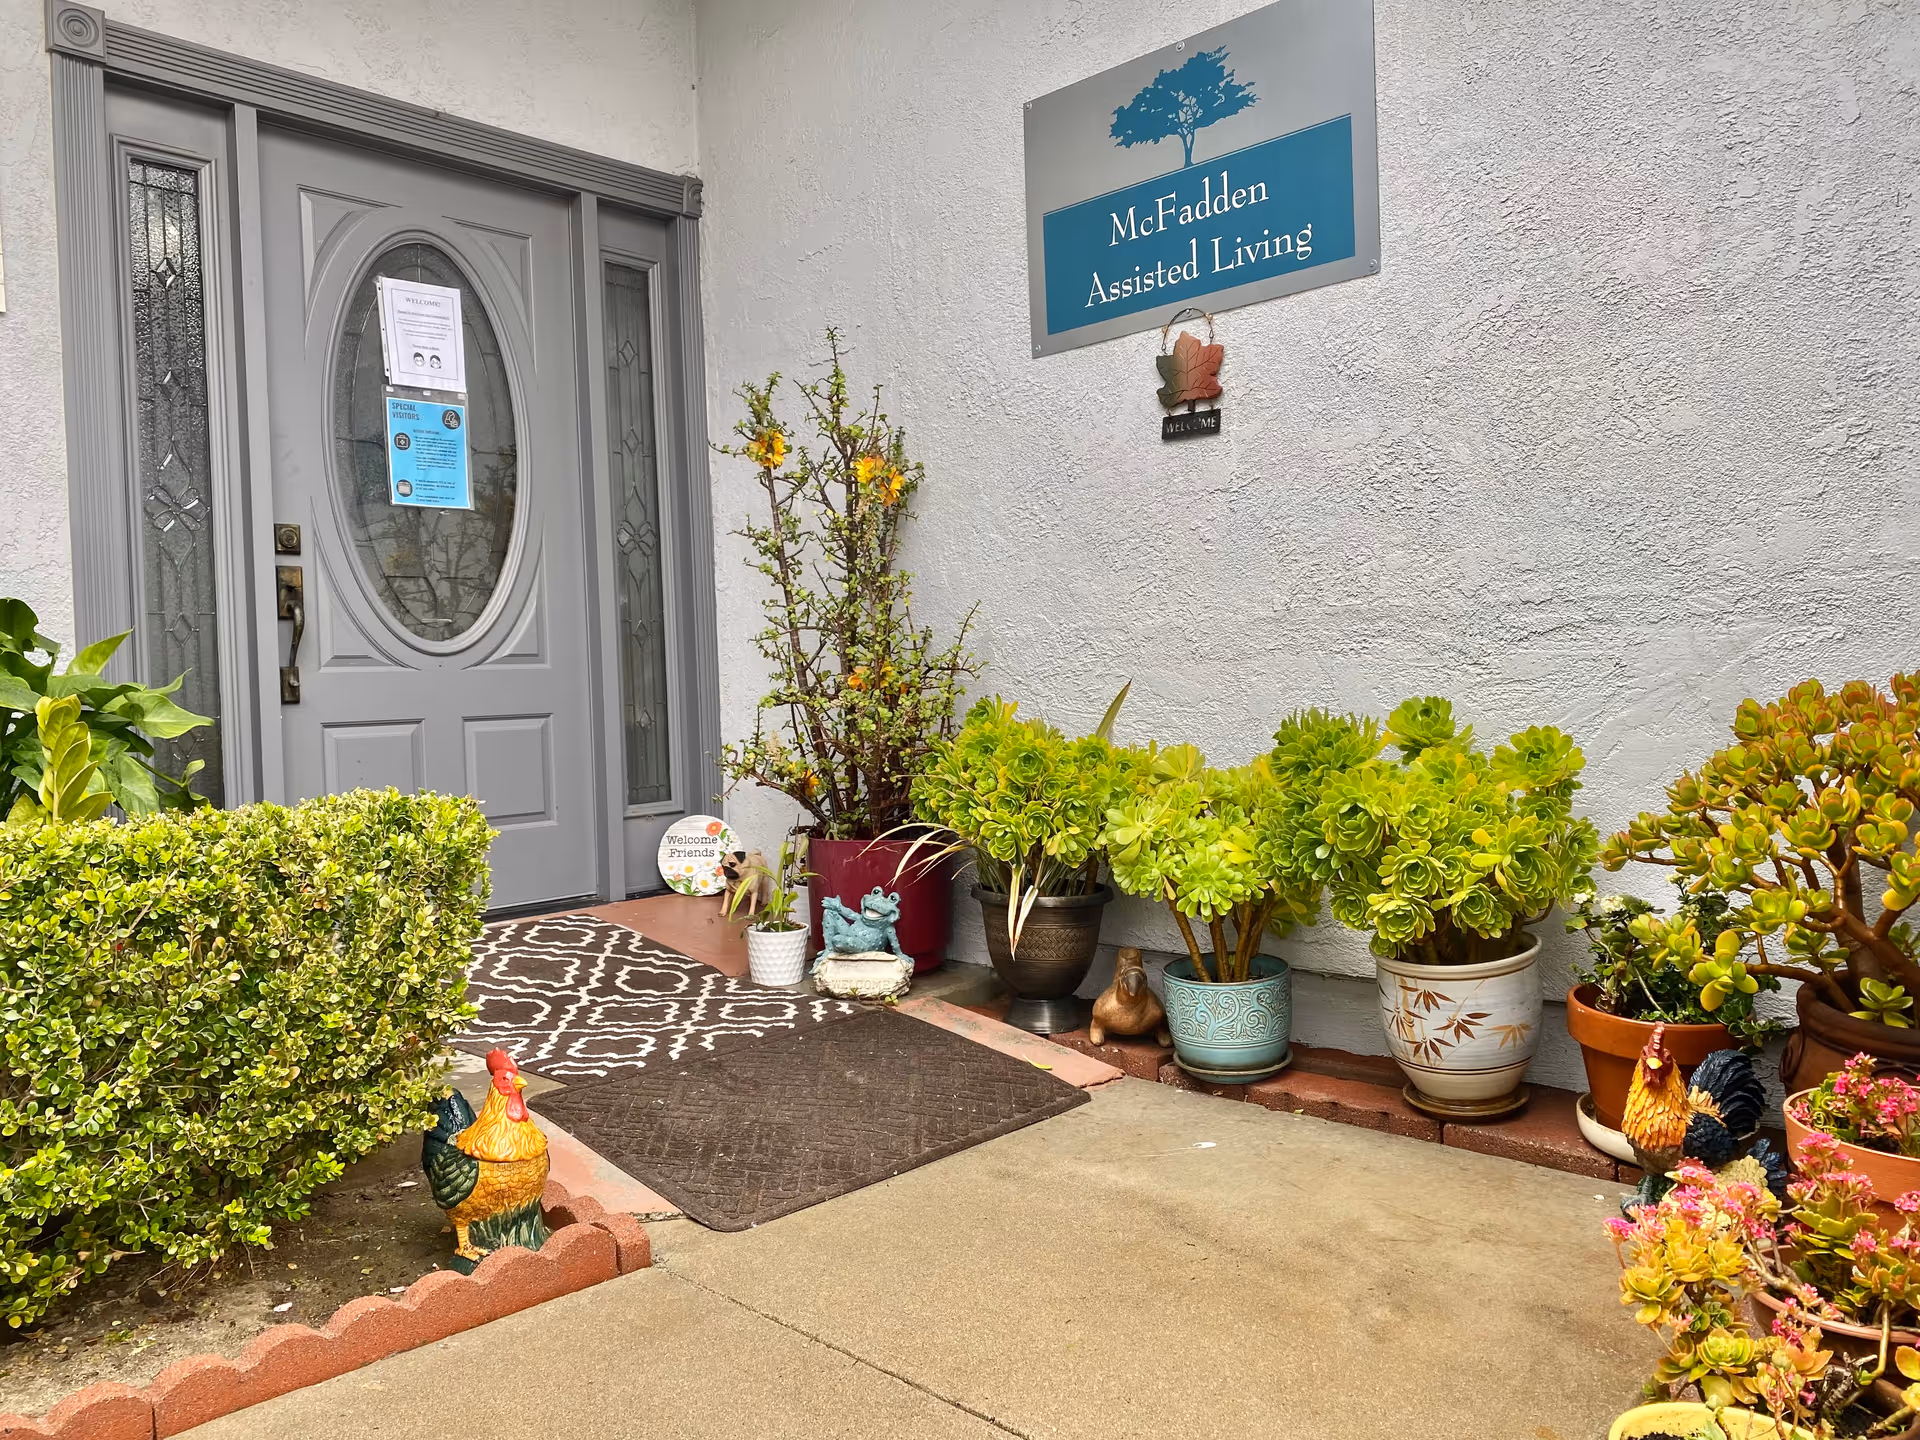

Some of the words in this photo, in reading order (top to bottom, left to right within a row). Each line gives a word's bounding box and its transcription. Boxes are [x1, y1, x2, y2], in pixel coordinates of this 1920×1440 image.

[1109, 171, 1269, 247] McFadden
[1085, 238, 1200, 308] Assisted
[1211, 223, 1312, 274] Living
[391, 402, 417, 412] SPECIAL
[392, 411, 420, 421] VISITORS
[666, 835, 718, 845] Welcome
[668, 847, 715, 858] Friends
[830, 979, 891, 990] WELCOME
